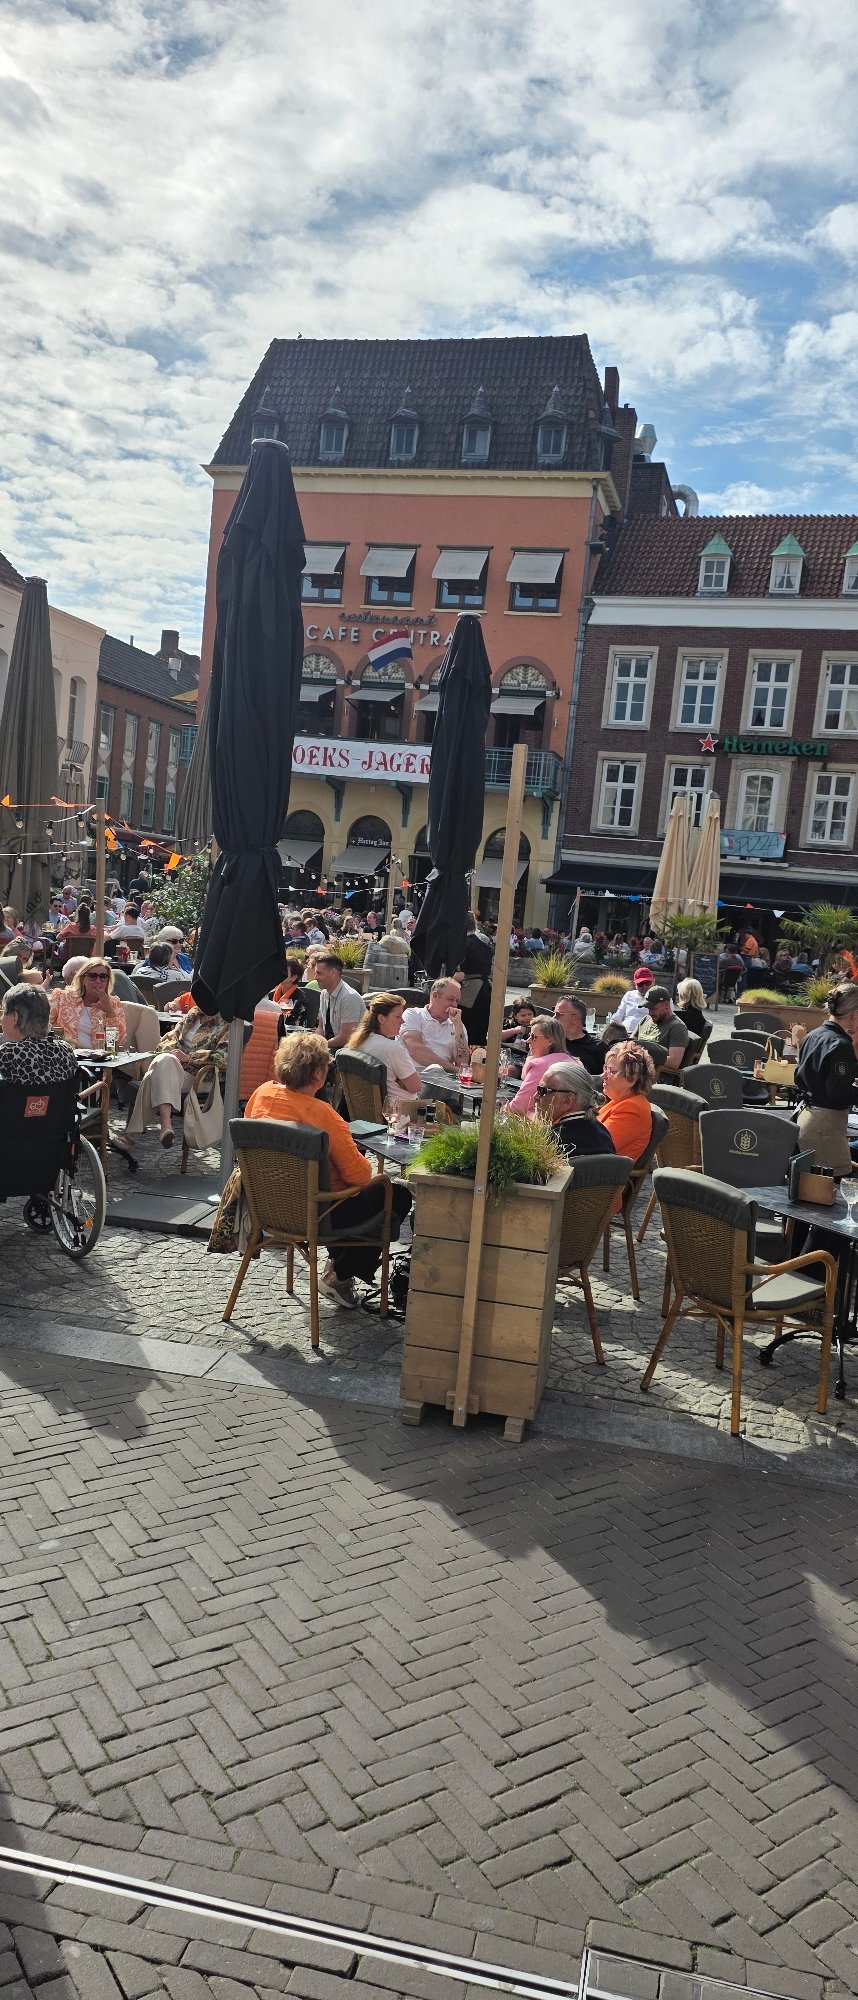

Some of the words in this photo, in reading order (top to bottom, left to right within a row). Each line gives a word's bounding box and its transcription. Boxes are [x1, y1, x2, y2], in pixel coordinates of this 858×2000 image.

[306, 624, 360, 642] CAFE
[723, 735, 829, 756] Heineken
[293, 744, 431, 774] OEKS-JAGER
[734, 833, 780, 853] PIZZA
